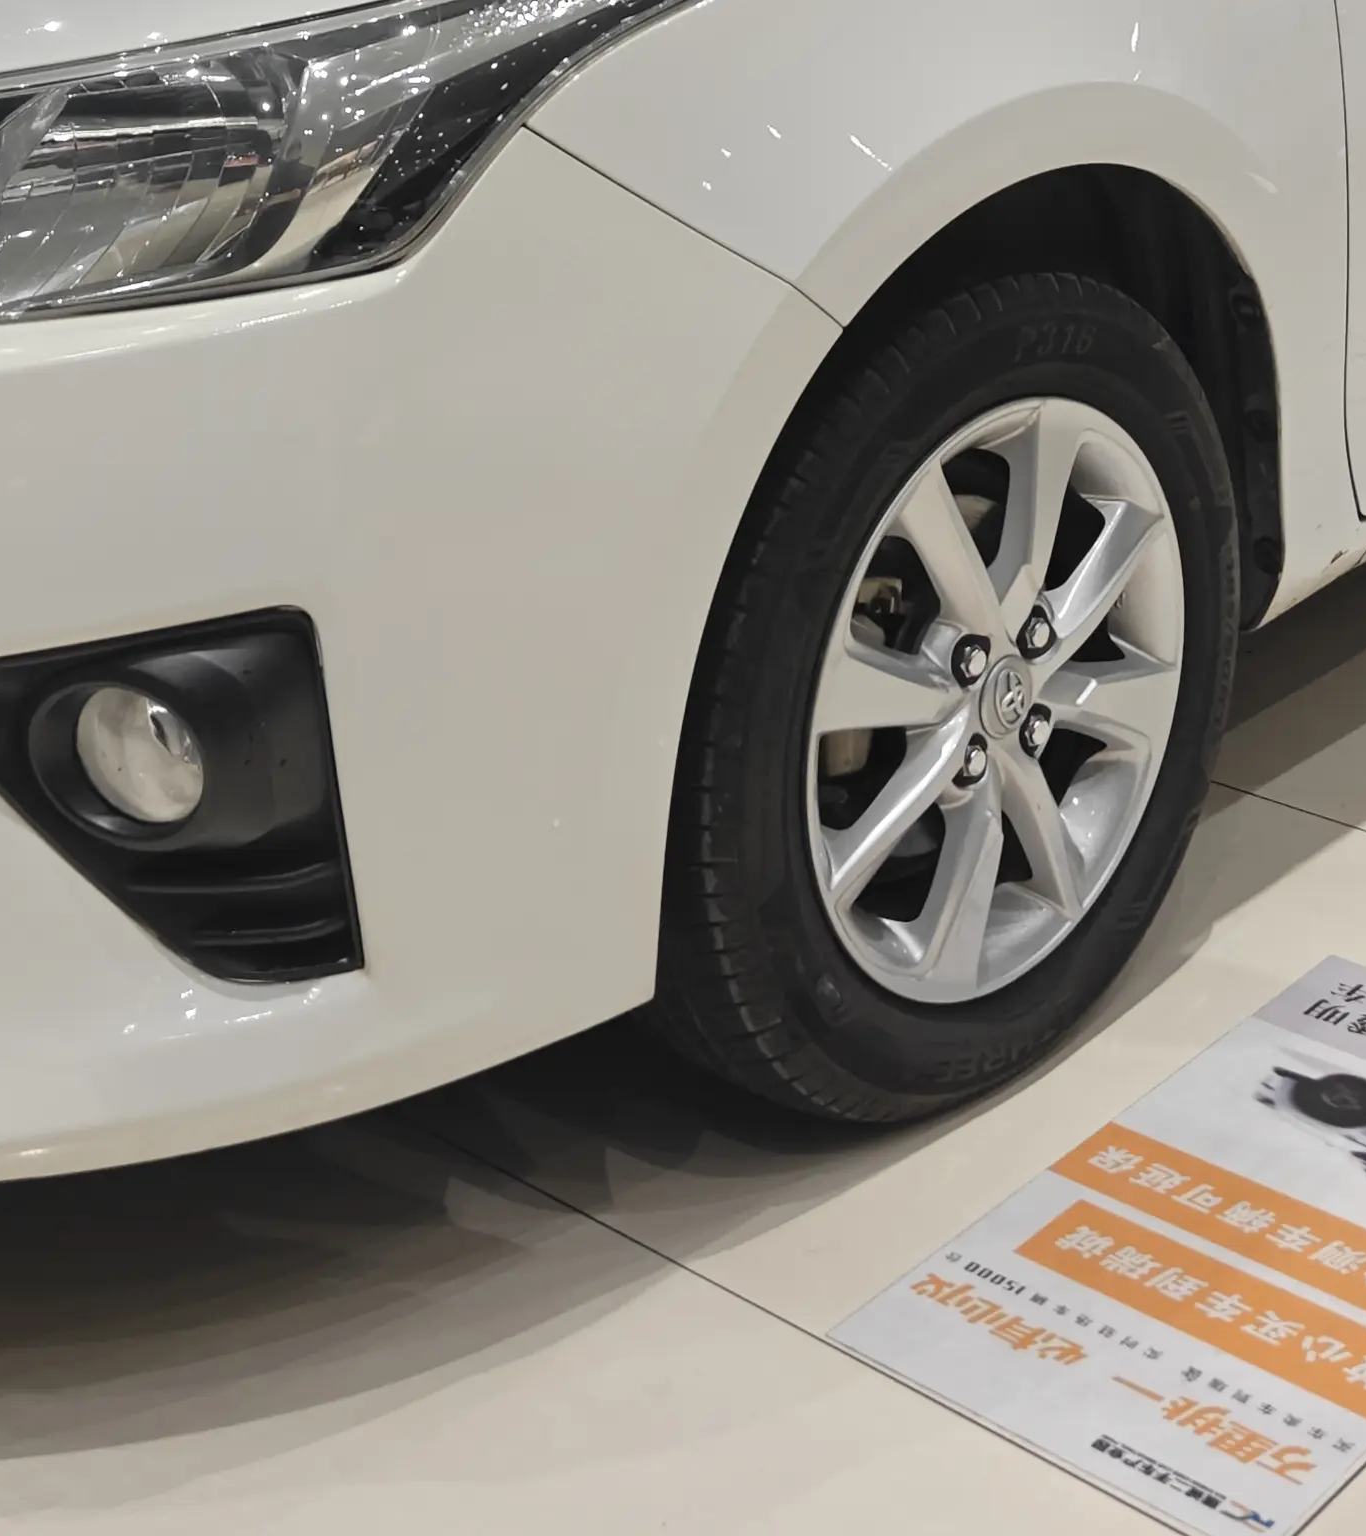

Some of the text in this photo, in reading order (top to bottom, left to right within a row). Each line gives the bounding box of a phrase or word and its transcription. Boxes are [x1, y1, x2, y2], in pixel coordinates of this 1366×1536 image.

[910, 1273, 1089, 1365] 必有心仪
[1111, 1375, 1316, 1486] 万里挑一
